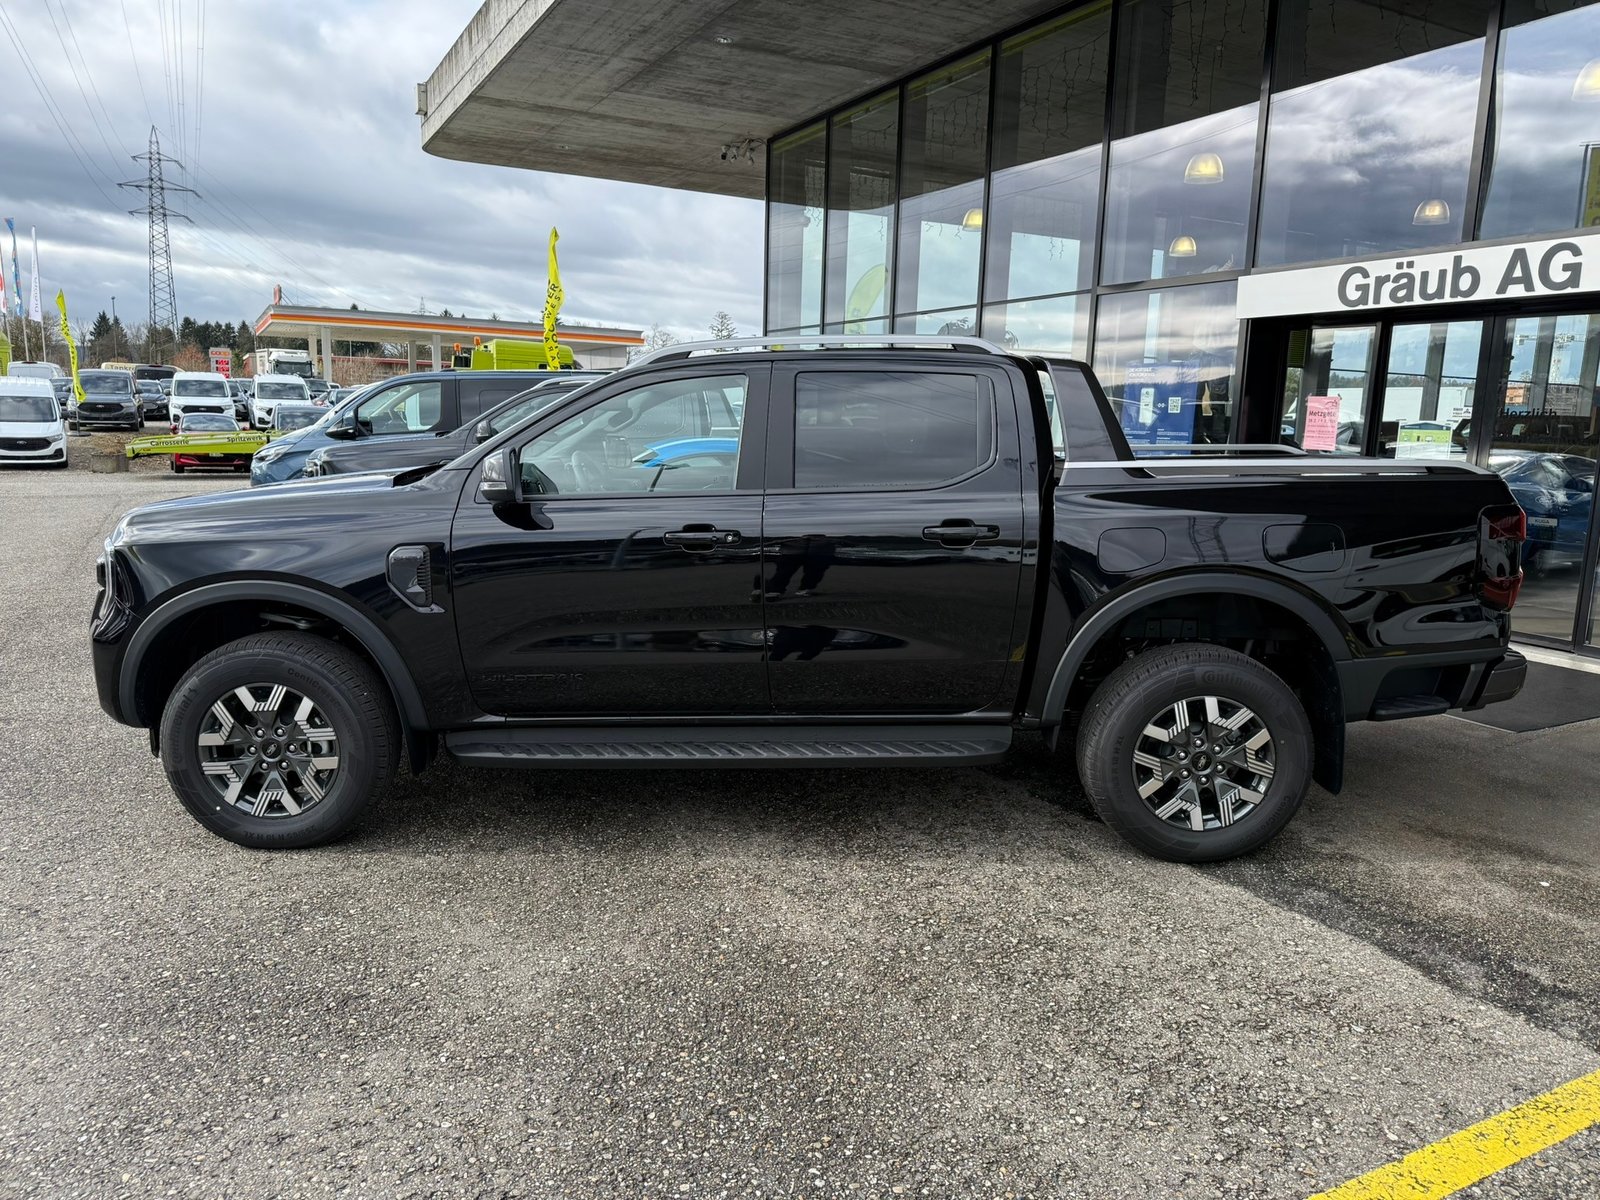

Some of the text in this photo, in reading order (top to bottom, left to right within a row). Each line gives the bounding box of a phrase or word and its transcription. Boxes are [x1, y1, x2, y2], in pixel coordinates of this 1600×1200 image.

[1338, 241, 1583, 309] Gräub AG
[1500, 408, 1557, 418] Herzlich
[150, 439, 190, 447] Carrosserie
[226, 435, 263, 443] Spritzwerk
